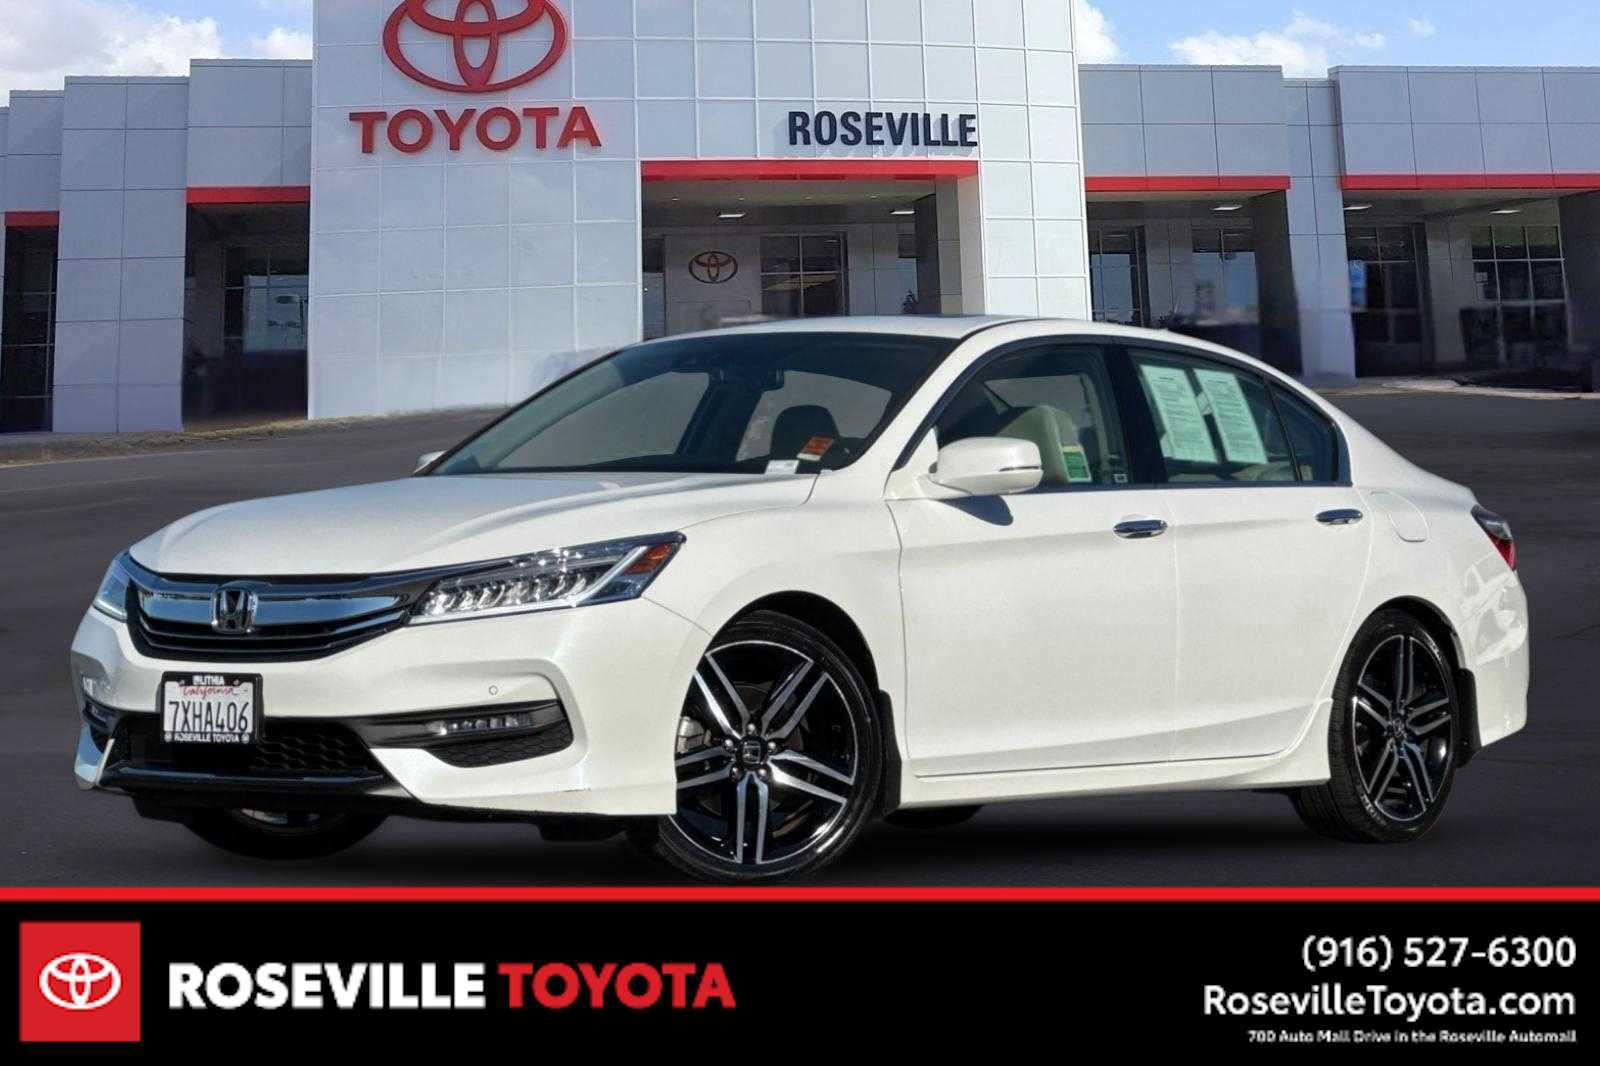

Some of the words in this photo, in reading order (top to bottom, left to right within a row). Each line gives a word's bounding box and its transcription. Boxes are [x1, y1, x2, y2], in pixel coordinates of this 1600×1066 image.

[350, 106, 602, 153] TOYOTA
[788, 111, 978, 147] ROSEVILLE
[200, 675, 225, 686] LITHIA
[169, 701, 249, 734] 7XHA406
[212, 733, 240, 743] TOYOTA
